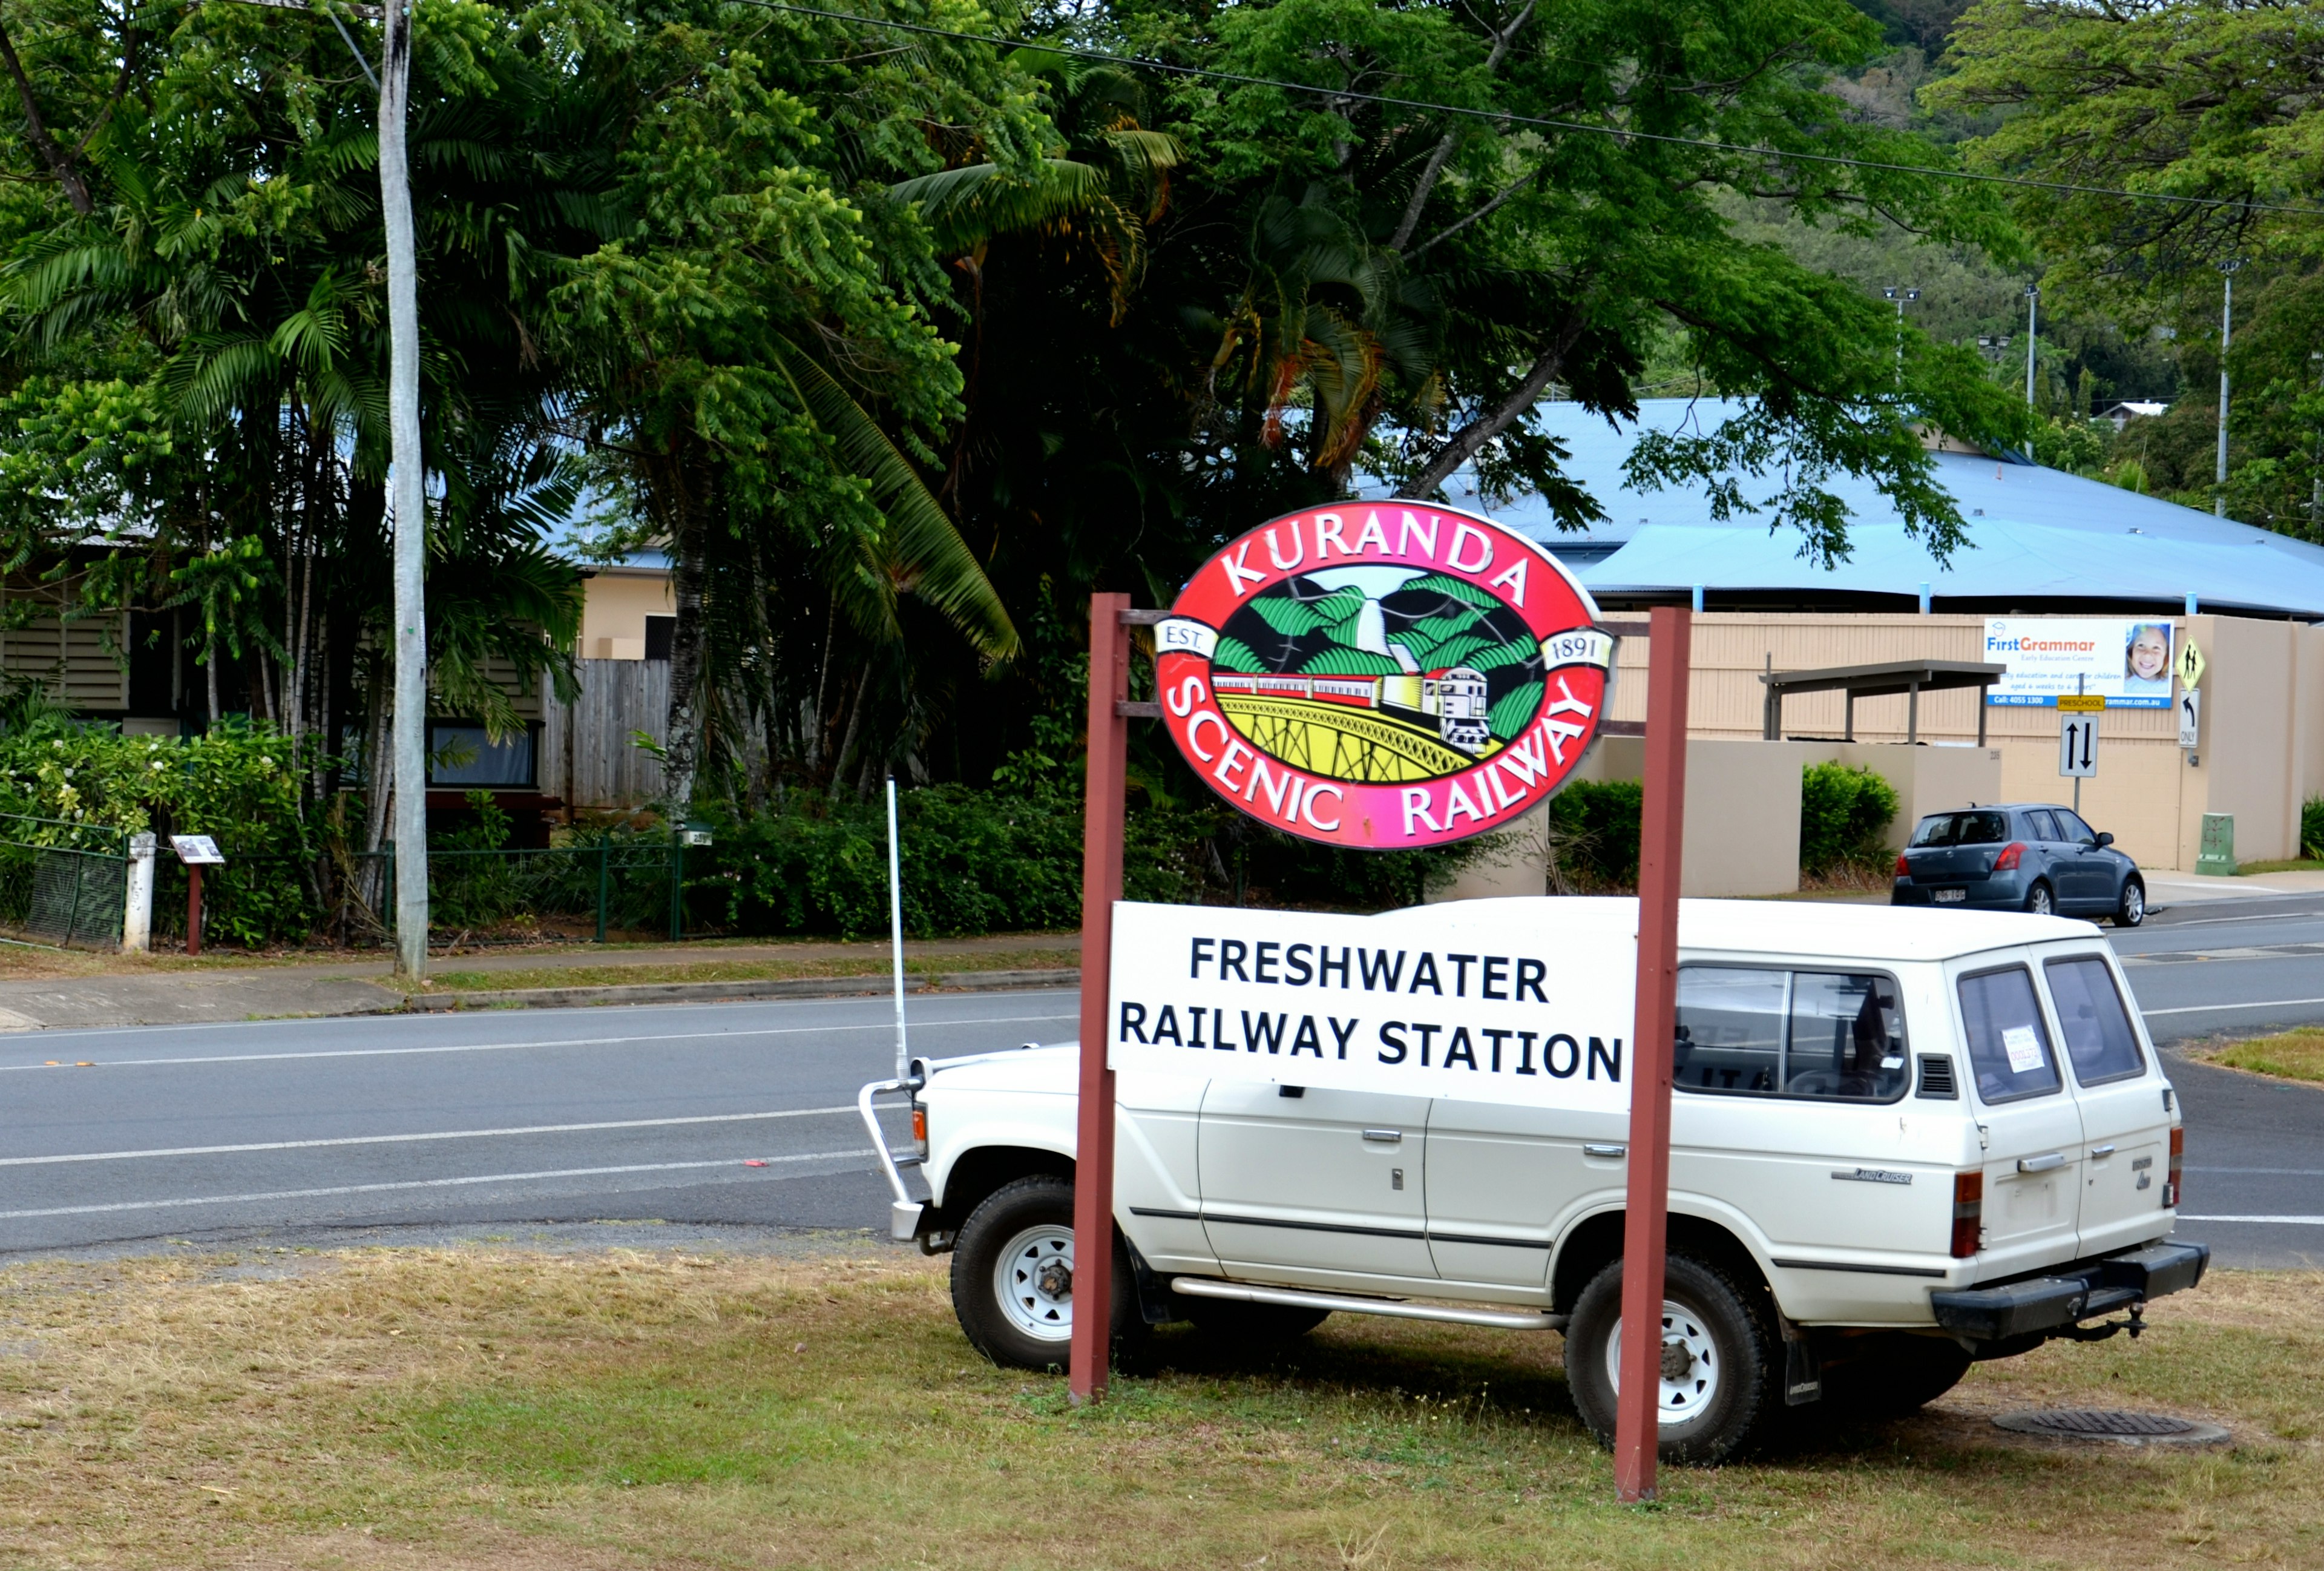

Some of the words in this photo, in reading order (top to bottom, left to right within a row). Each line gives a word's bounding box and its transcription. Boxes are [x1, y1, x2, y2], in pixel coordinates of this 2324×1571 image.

[1221, 510, 1529, 608] KURANDA
[1166, 625, 1200, 650] EST.
[1552, 639, 1597, 659] 1891
[1167, 676, 1343, 832] SCENIC
[1401, 675, 1593, 835] RAILWAY
[2181, 731, 2195, 742] ONLY
[1190, 937, 1551, 1004] FRESHWATER
[1120, 1001, 1359, 1060] RAILWAY
[1377, 1021, 1623, 1083] STATION
